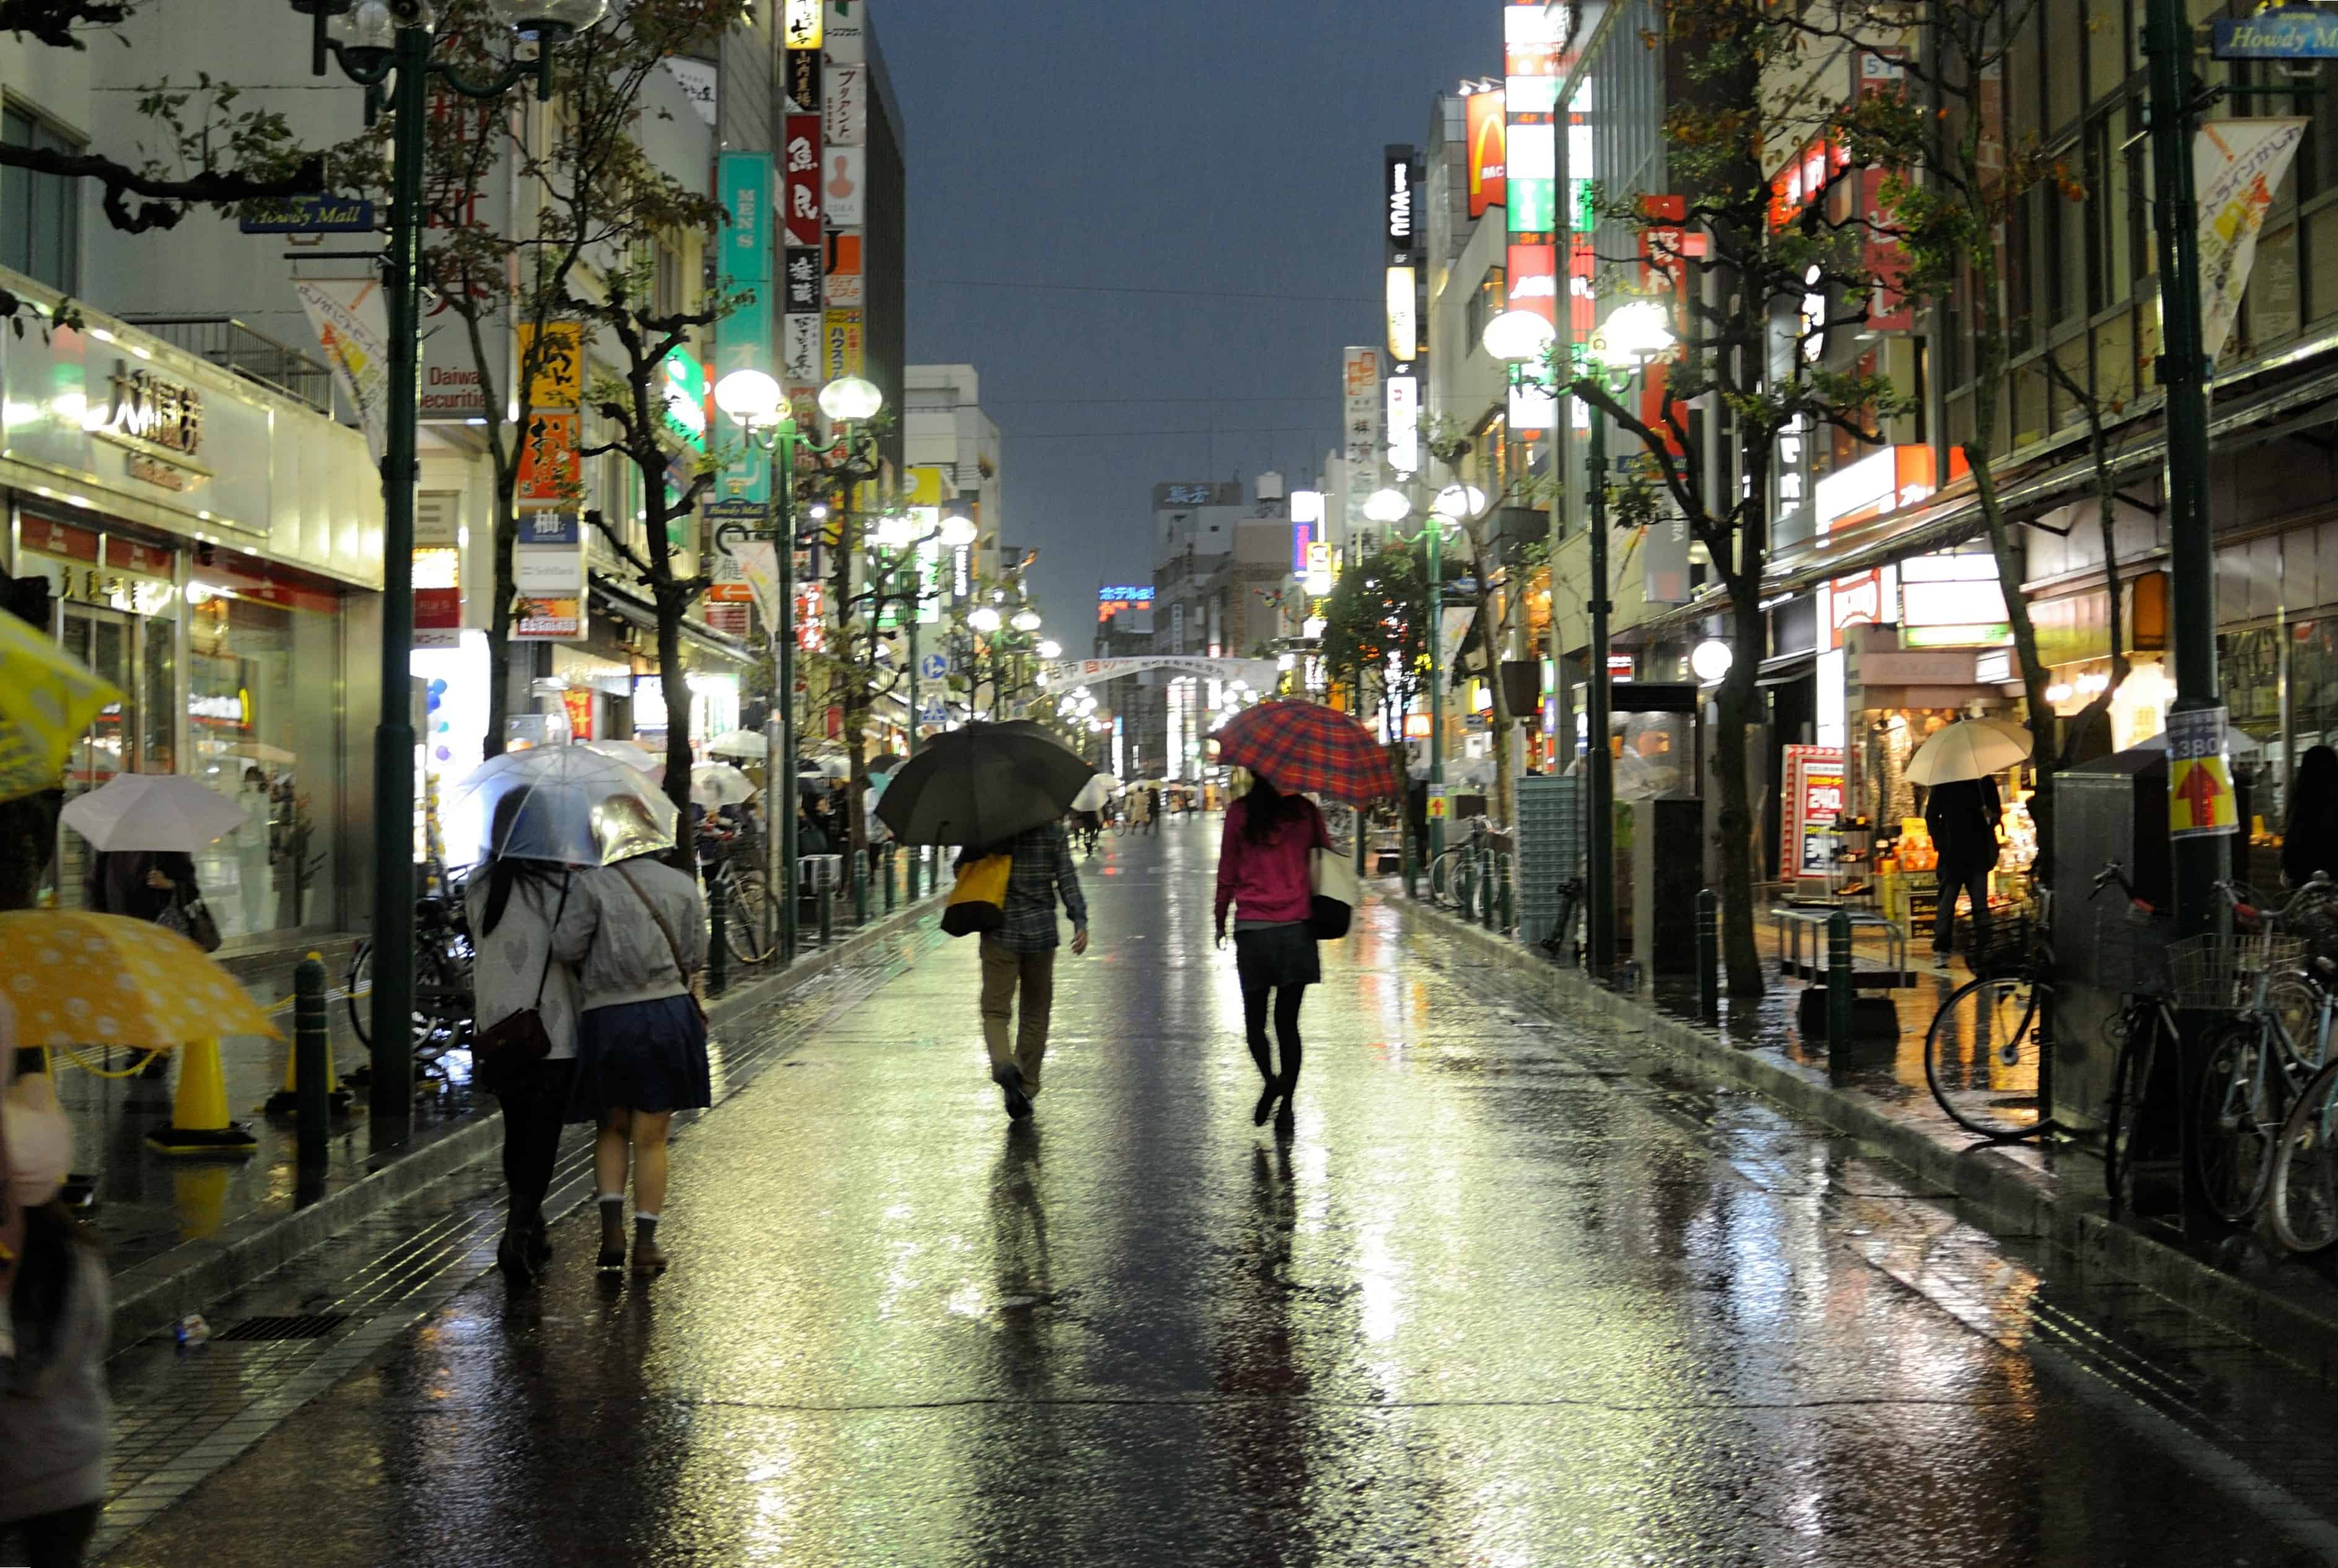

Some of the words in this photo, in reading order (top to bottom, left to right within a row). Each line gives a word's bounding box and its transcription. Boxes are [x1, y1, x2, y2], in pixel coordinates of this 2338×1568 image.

[2230, 26, 2306, 52] Howdy
[788, 136, 818, 220] 魚民
[315, 205, 361, 224] Mall
[1390, 190, 1411, 237] WUU
[429, 367, 480, 385] Daiwa
[421, 389, 486, 408] ecuritie
[535, 566, 575, 575] SoftBank
[2178, 737, 2217, 756] 380
